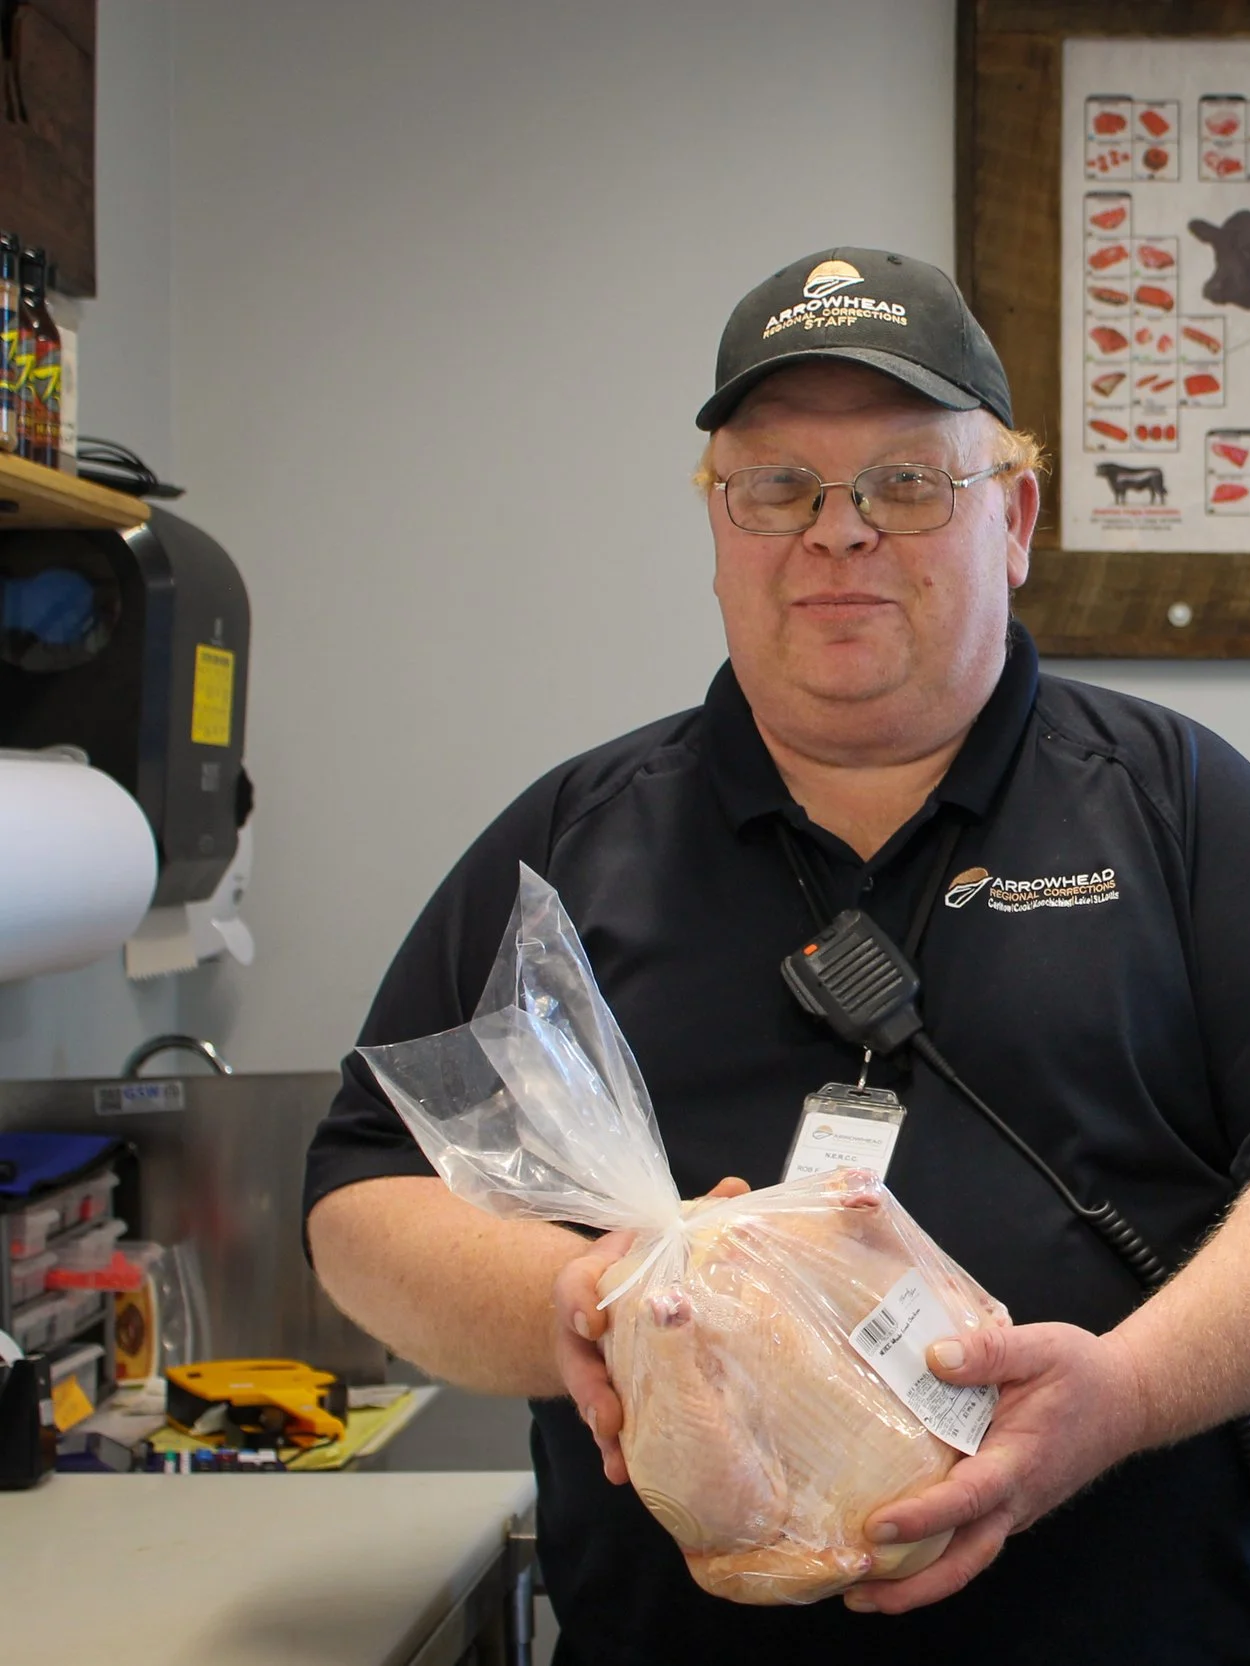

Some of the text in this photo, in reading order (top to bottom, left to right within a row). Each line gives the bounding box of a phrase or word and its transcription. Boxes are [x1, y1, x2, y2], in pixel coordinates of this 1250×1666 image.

[762, 308, 908, 339] REGIONAL CORRECTIONS
[765, 295, 906, 329] ARROWHEAD
[804, 316, 857, 330] STAFF
[989, 880, 1116, 902] REGIONAL CORRECTIONS
[992, 868, 1115, 892] ARROWHEAD
